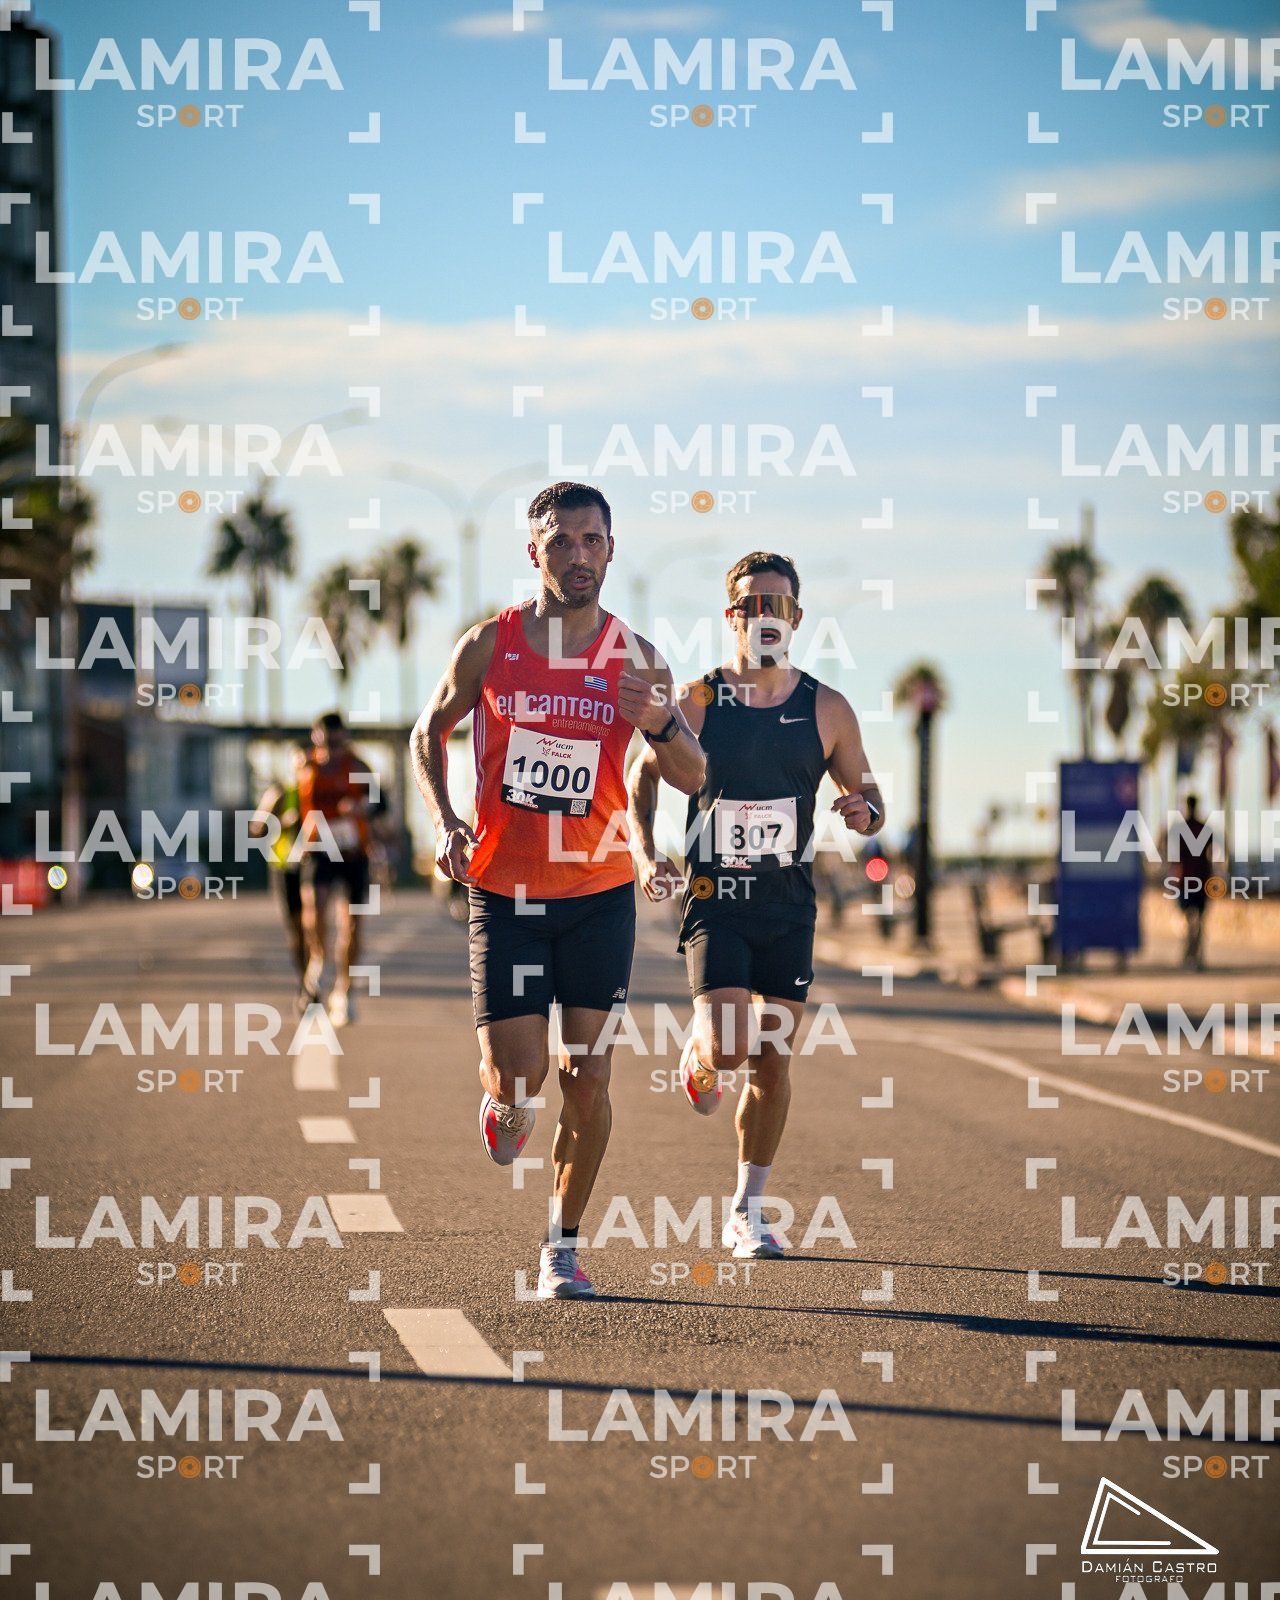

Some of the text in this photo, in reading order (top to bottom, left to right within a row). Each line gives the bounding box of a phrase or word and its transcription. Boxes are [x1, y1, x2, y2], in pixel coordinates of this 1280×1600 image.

[513, 755, 591, 794] 1000
[506, 788, 538, 805] 30K
[730, 824, 783, 850] 807
